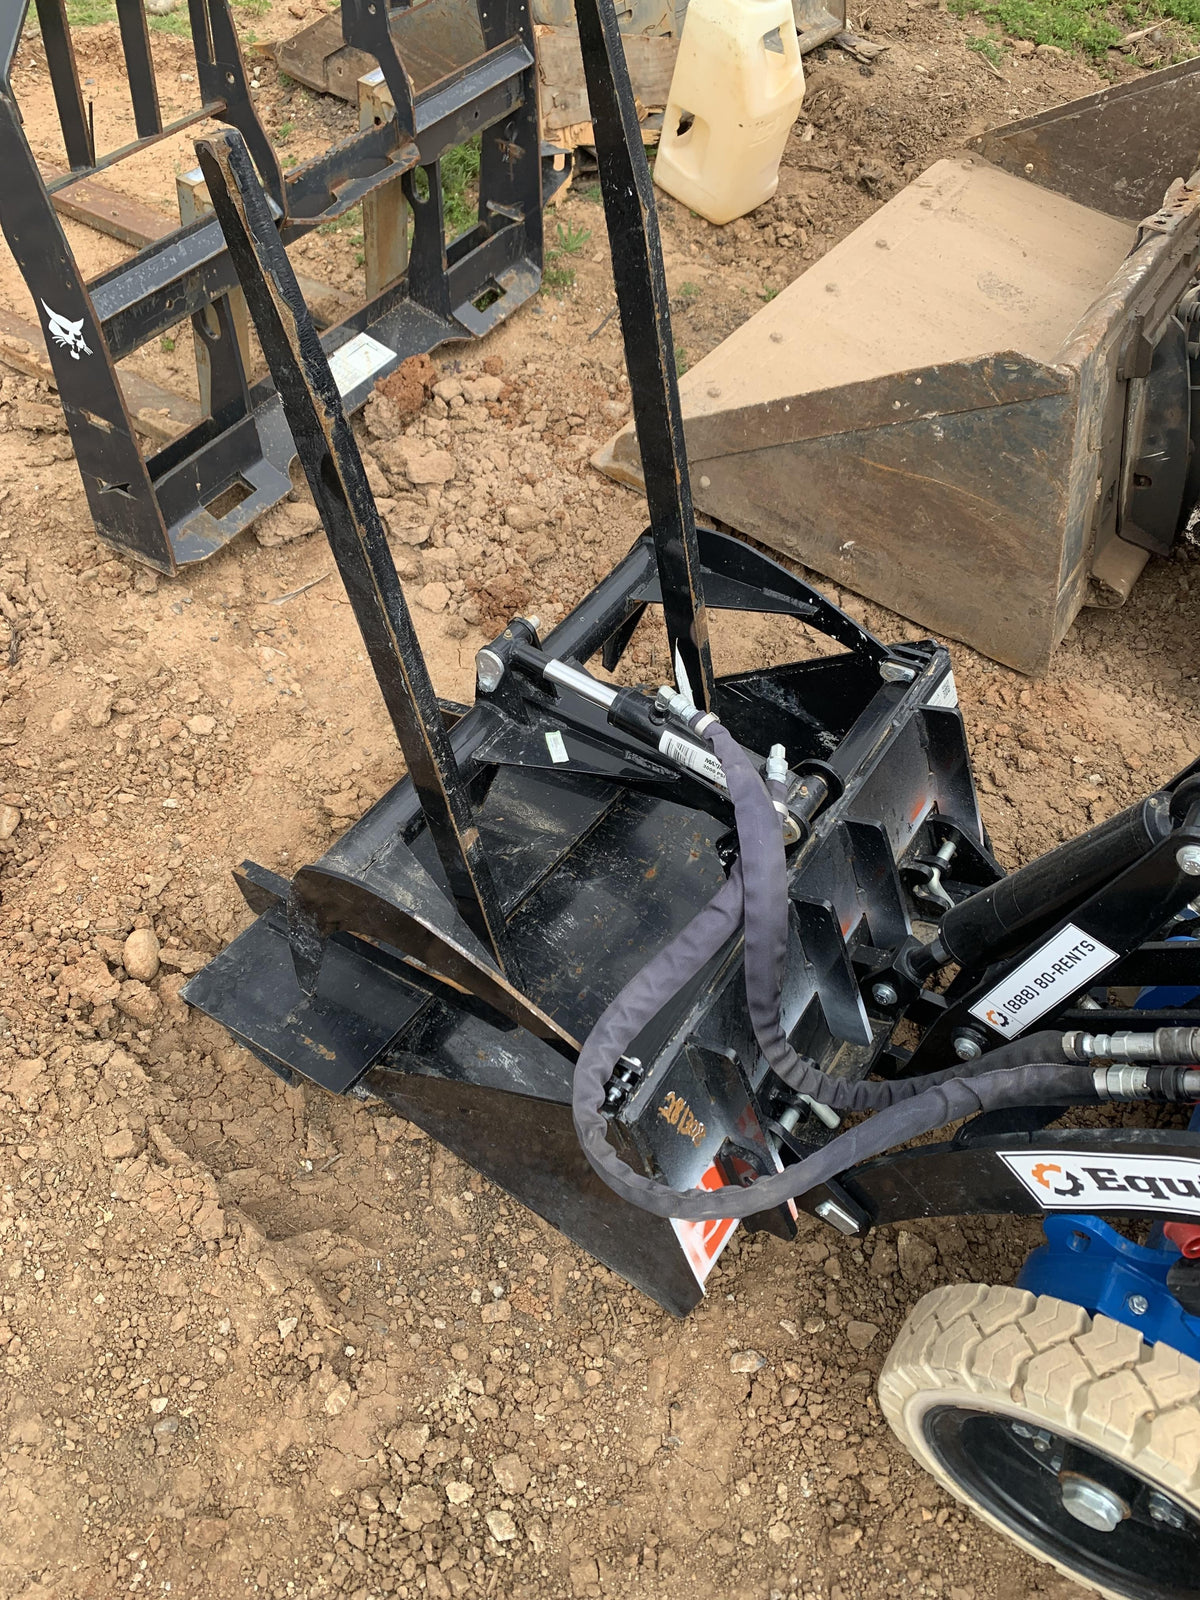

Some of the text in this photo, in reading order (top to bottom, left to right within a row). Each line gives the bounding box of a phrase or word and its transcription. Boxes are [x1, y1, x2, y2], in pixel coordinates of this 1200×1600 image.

[1003, 940, 1096, 1014] (888) 80-RENTS
[1080, 1167, 1200, 1200] Equ
